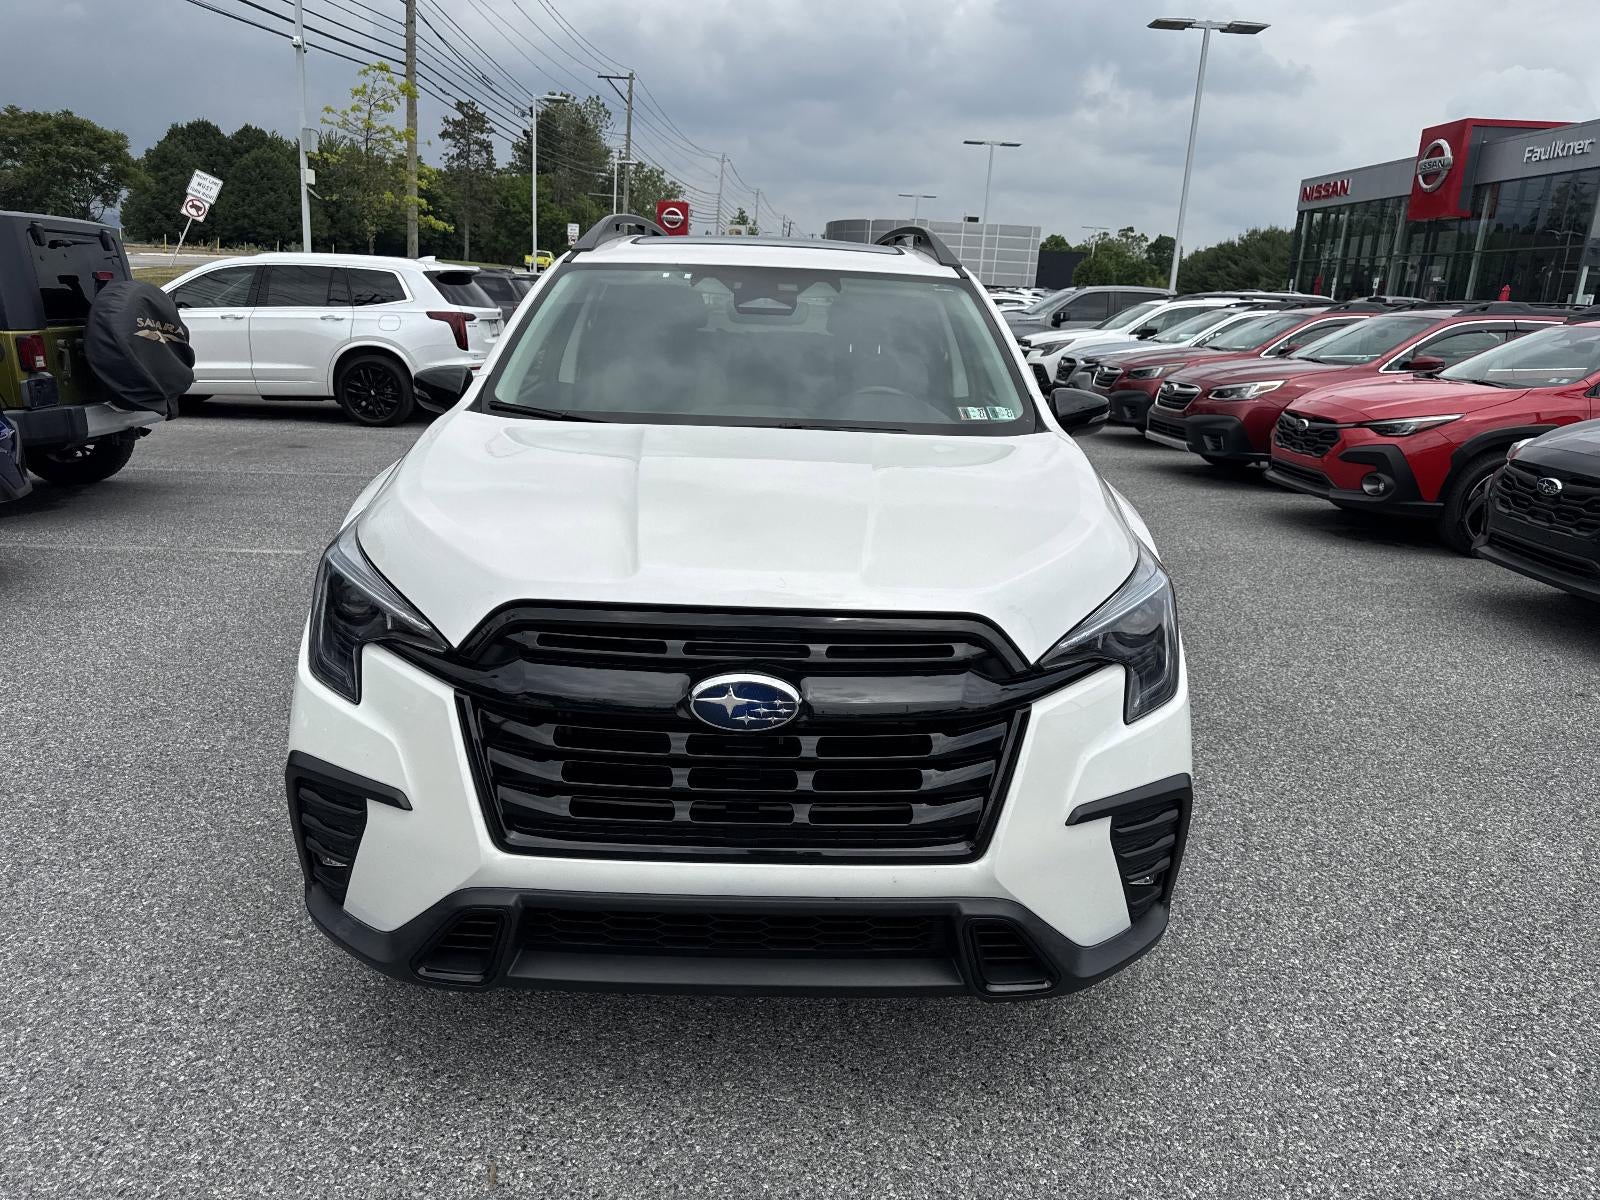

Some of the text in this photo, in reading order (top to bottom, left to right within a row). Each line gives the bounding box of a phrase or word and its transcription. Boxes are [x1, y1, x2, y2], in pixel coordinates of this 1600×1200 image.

[1523, 139, 1592, 163] Faulkner
[1419, 159, 1446, 172] SSAN
[197, 182, 213, 192] MUST
[1301, 178, 1350, 202] NISSAN
